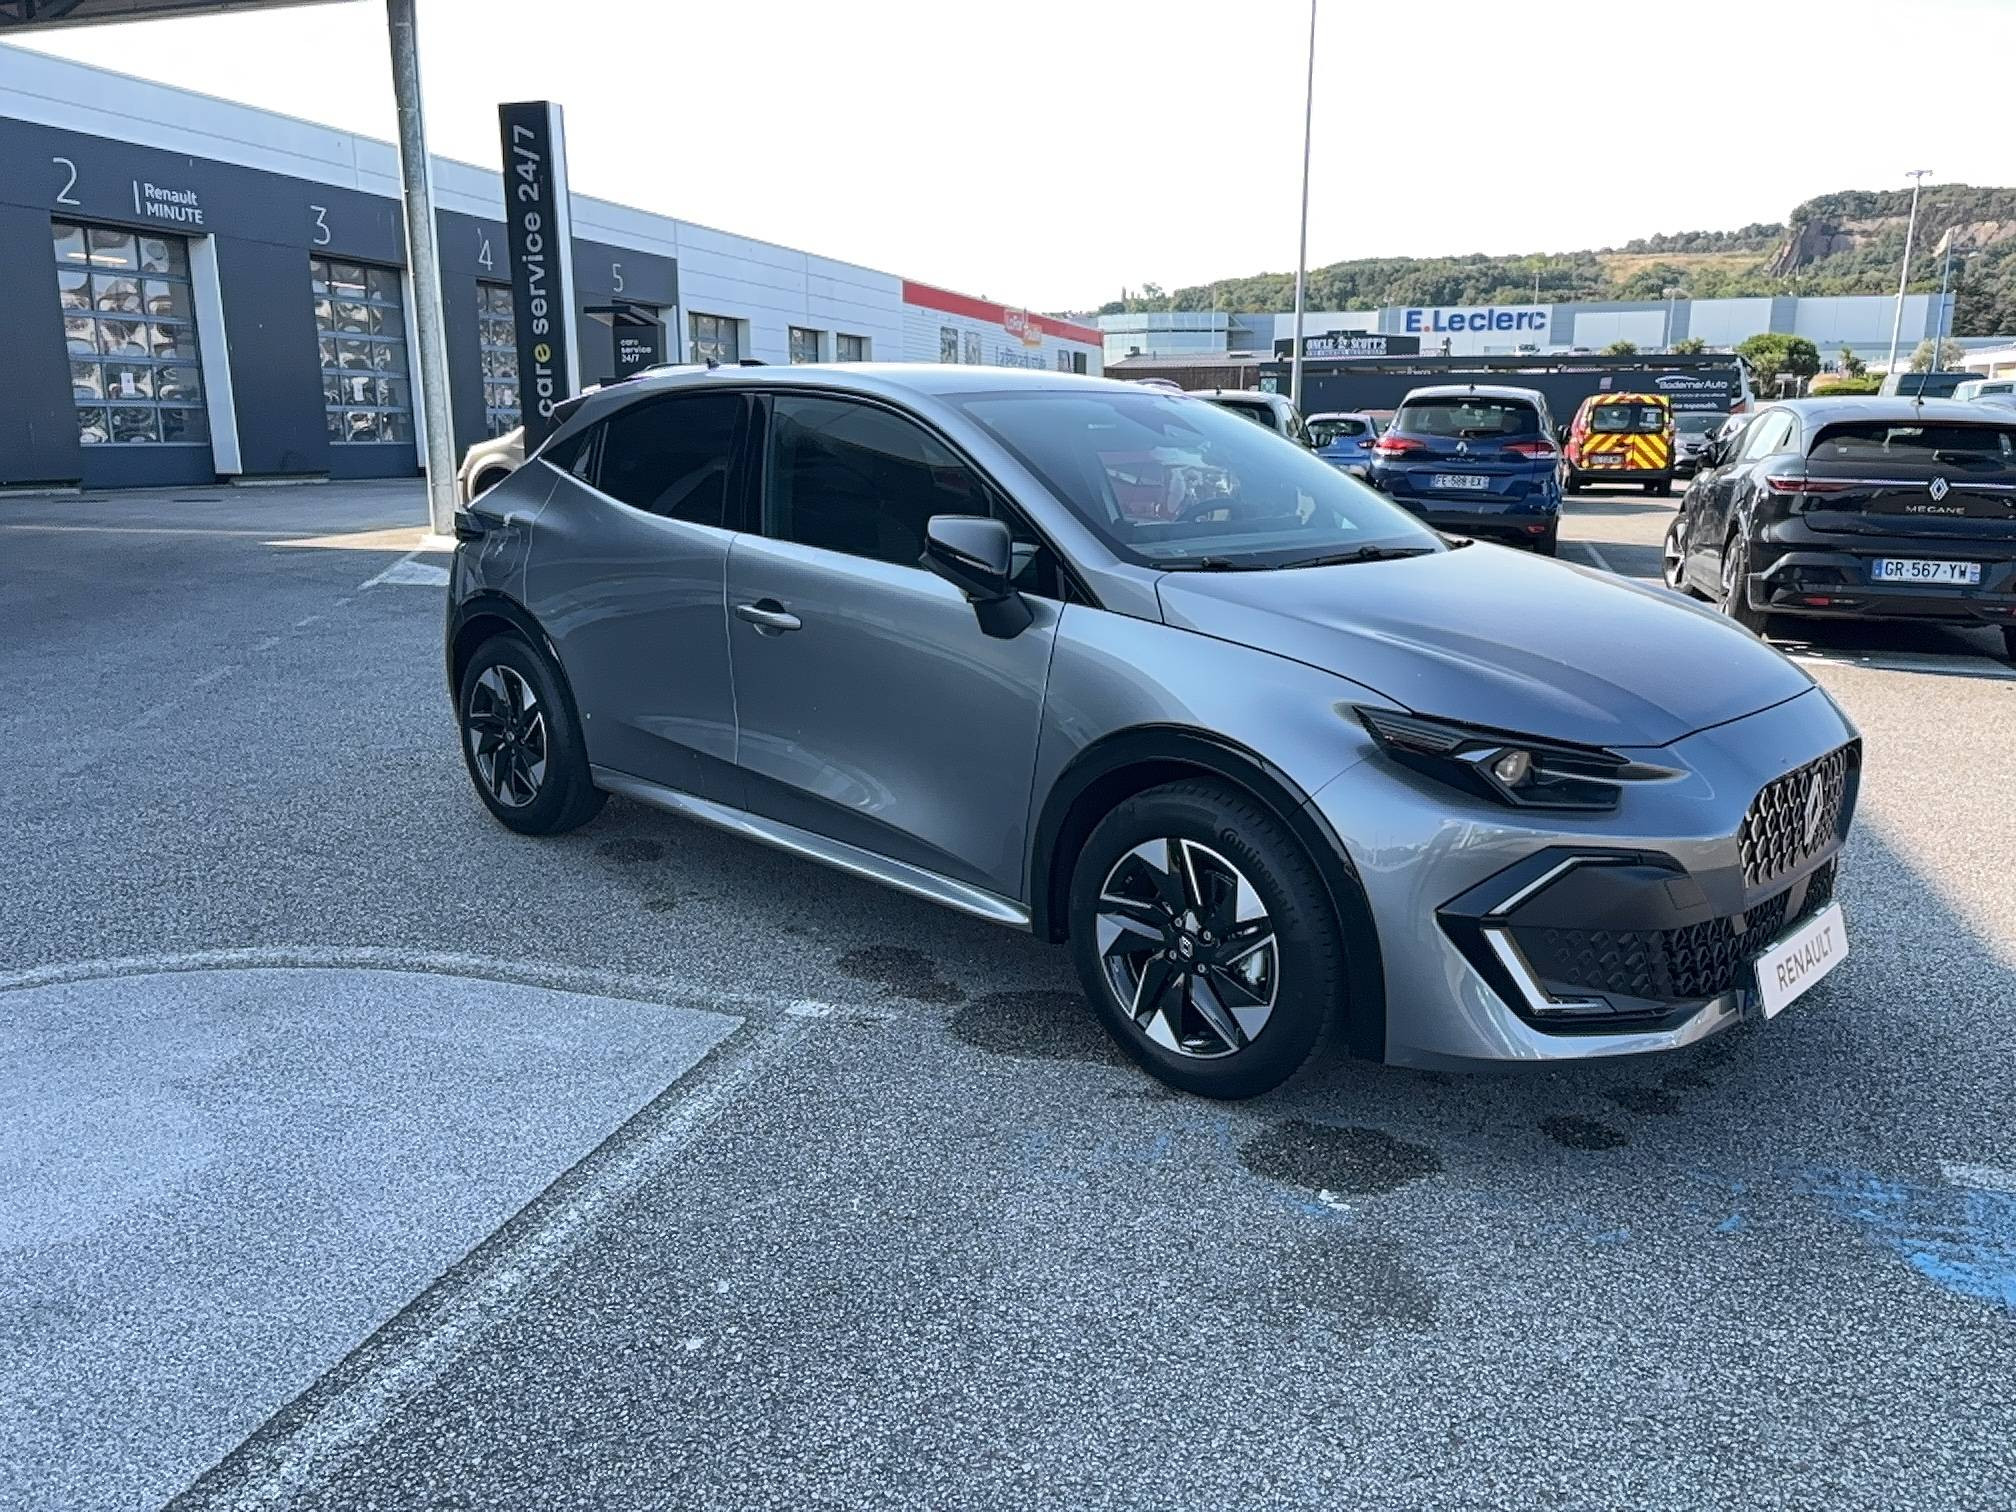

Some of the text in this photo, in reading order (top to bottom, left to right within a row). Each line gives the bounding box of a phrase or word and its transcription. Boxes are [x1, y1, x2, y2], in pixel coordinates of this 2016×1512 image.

[52, 157, 81, 205] 2
[143, 183, 199, 206] Renault
[145, 202, 204, 224] MINUTE
[310, 205, 331, 246] 3
[478, 239, 494, 271] 4
[513, 125, 555, 418] care service 24/7
[612, 263, 624, 293] 5
[1406, 308, 1547, 332] E.Leclerc
[622, 354, 640, 363] 24/7
[1776, 926, 1833, 992] RENAULT
